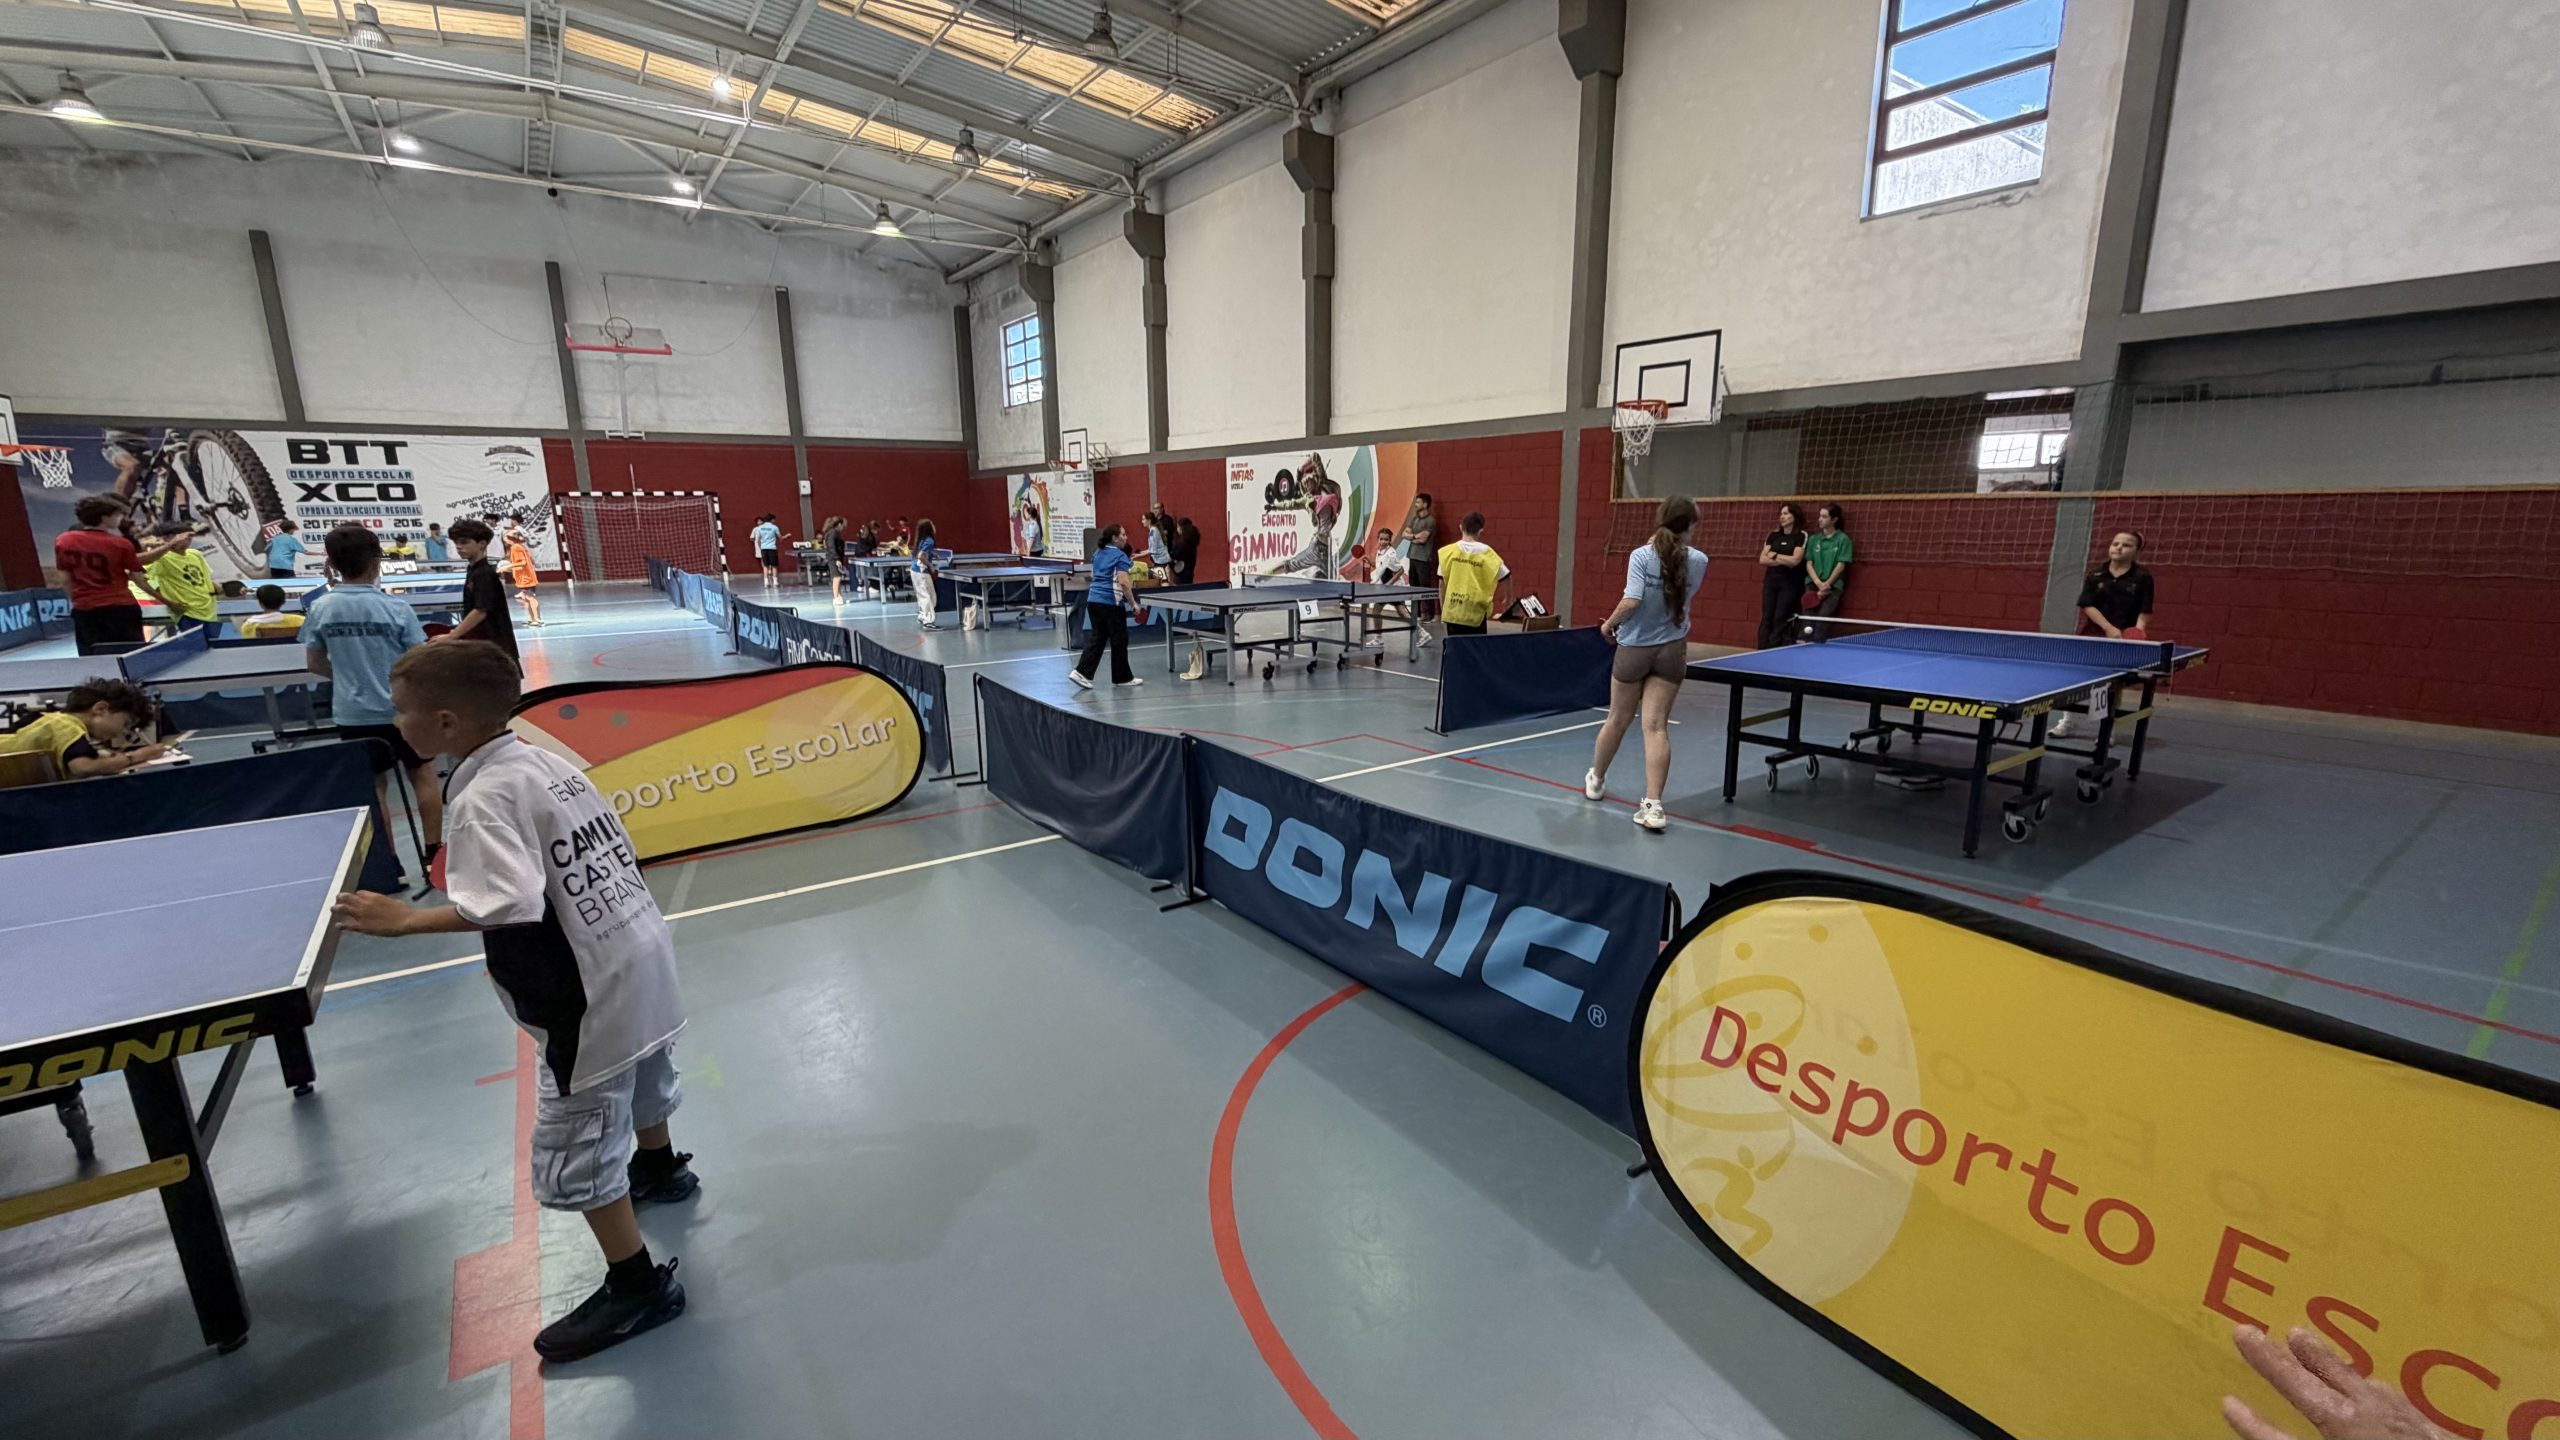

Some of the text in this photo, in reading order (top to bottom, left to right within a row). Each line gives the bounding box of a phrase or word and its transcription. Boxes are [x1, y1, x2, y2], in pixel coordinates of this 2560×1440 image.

[286, 438, 408, 465] BTT
[290, 470, 412, 479] DESPORTO ESCOLAR
[1231, 469, 1254, 481] INFIAS
[292, 483, 417, 502] XCO
[481, 491, 526, 510] ESCOLAS
[306, 506, 331, 515] PROVA
[346, 506, 381, 514] CIRCUITO
[386, 506, 421, 514] REGIONAL
[1261, 513, 1297, 527] ENCONTRO
[303, 520, 320, 529] 20
[394, 518, 423, 528] 2016
[1229, 526, 1298, 563] GÍMNICO
[1039, 576, 1045, 584] 8
[1232, 567, 1237, 576] 3
[1304, 604, 1312, 615] 9
[1908, 697, 1999, 719] DONIC
[2095, 690, 2107, 712] 10
[606, 717, 897, 817] porto Escolar
[547, 775, 586, 803] TÉNIS
[550, 812, 621, 868] CAMIL
[563, 844, 633, 897] CASTE
[576, 870, 646, 926] BRAN
[1203, 785, 1610, 1024] DONIC
[0, 1012, 258, 1098] DONIC
[1700, 1006, 2157, 1267] Desporto
